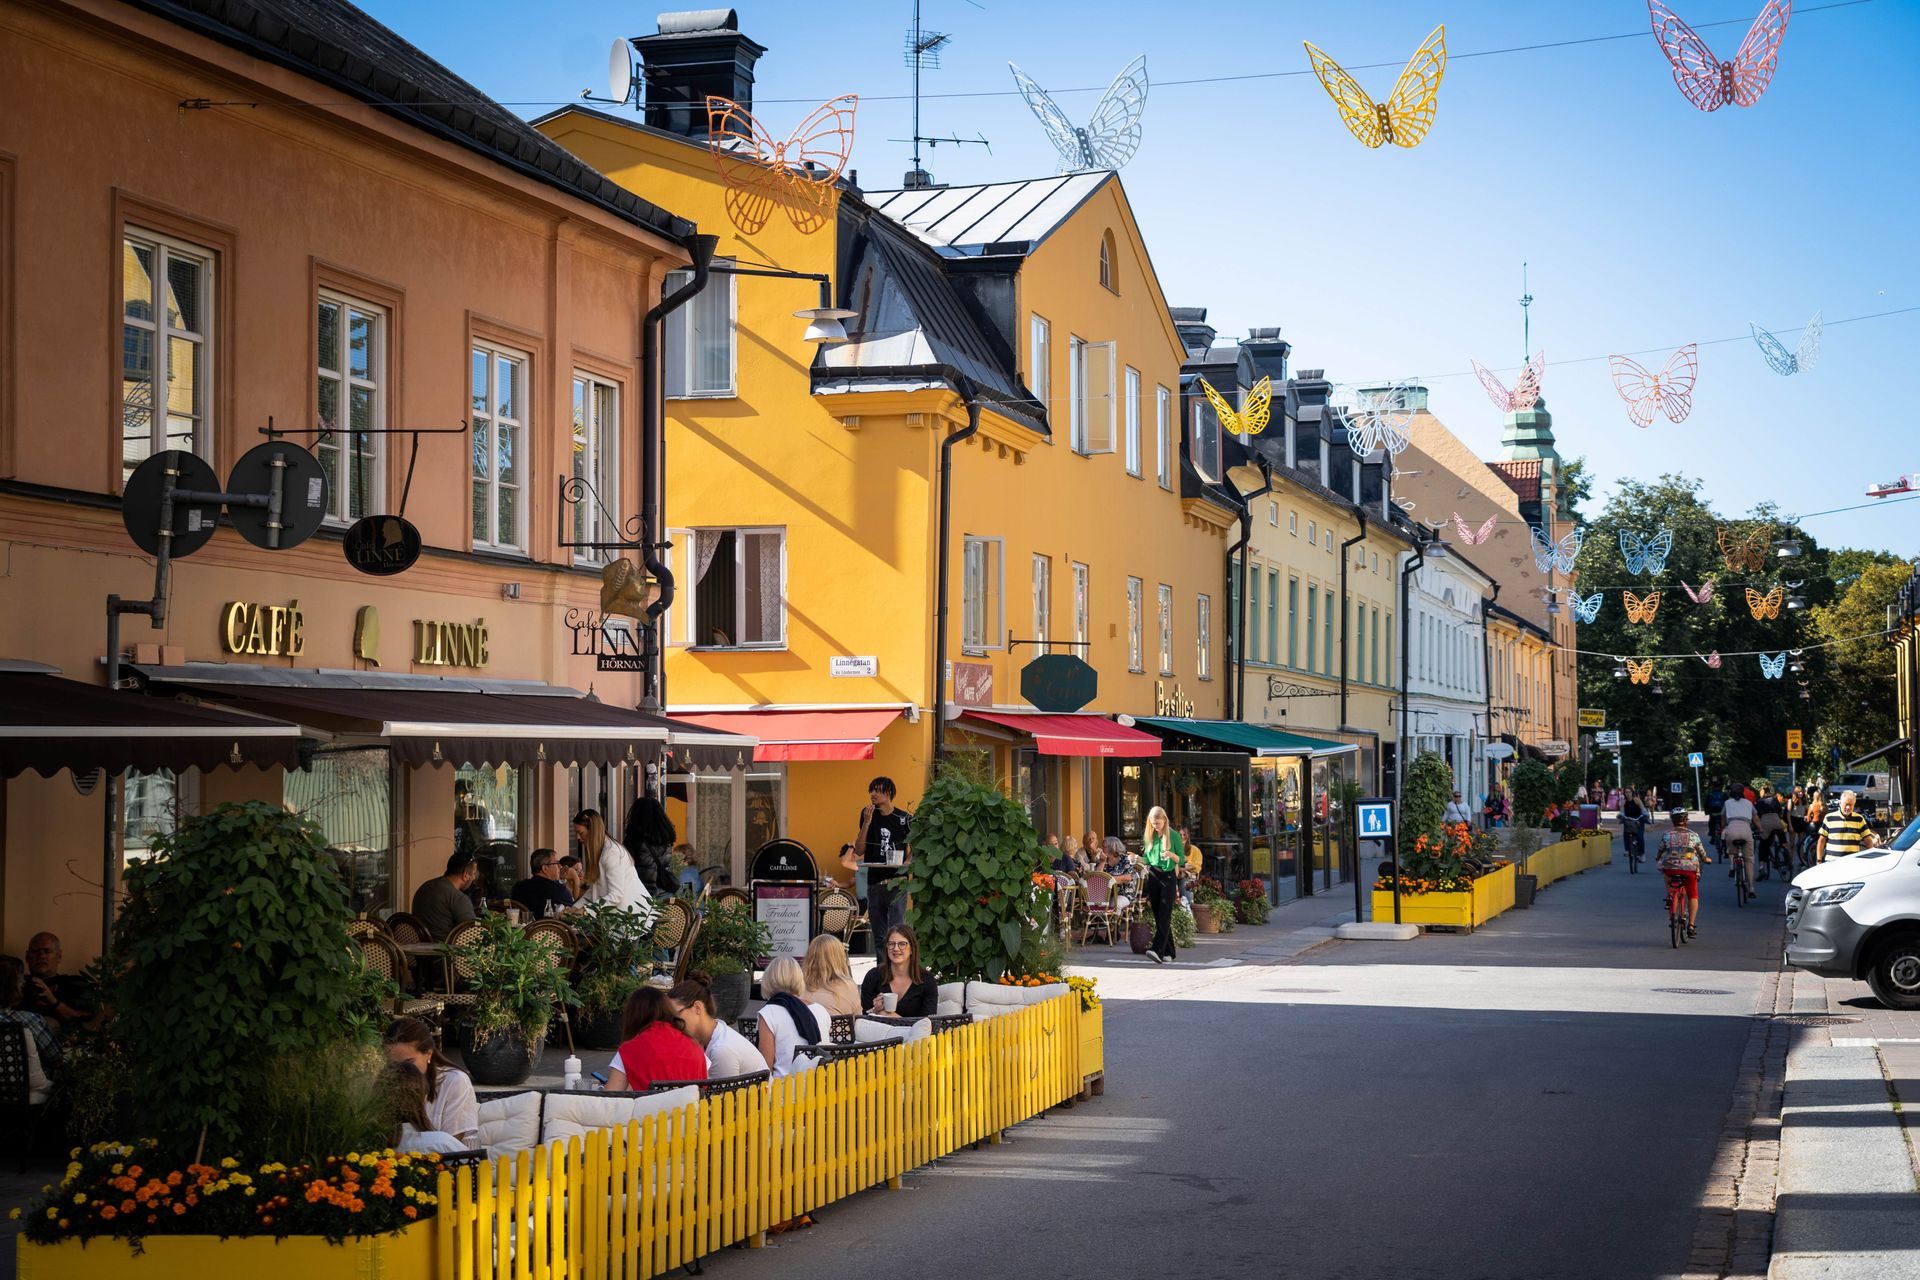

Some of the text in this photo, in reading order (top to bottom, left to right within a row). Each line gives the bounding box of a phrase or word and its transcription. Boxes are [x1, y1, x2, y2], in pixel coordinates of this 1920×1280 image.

[221, 600, 489, 668] CAFÉ LINNÉ
[601, 657, 645, 669] HÖRNAN
[835, 657, 871, 667] Linnégatan
[1155, 681, 1194, 718] Basilico
[765, 906, 801, 918] Frukost
[773, 941, 794, 953] Fika
